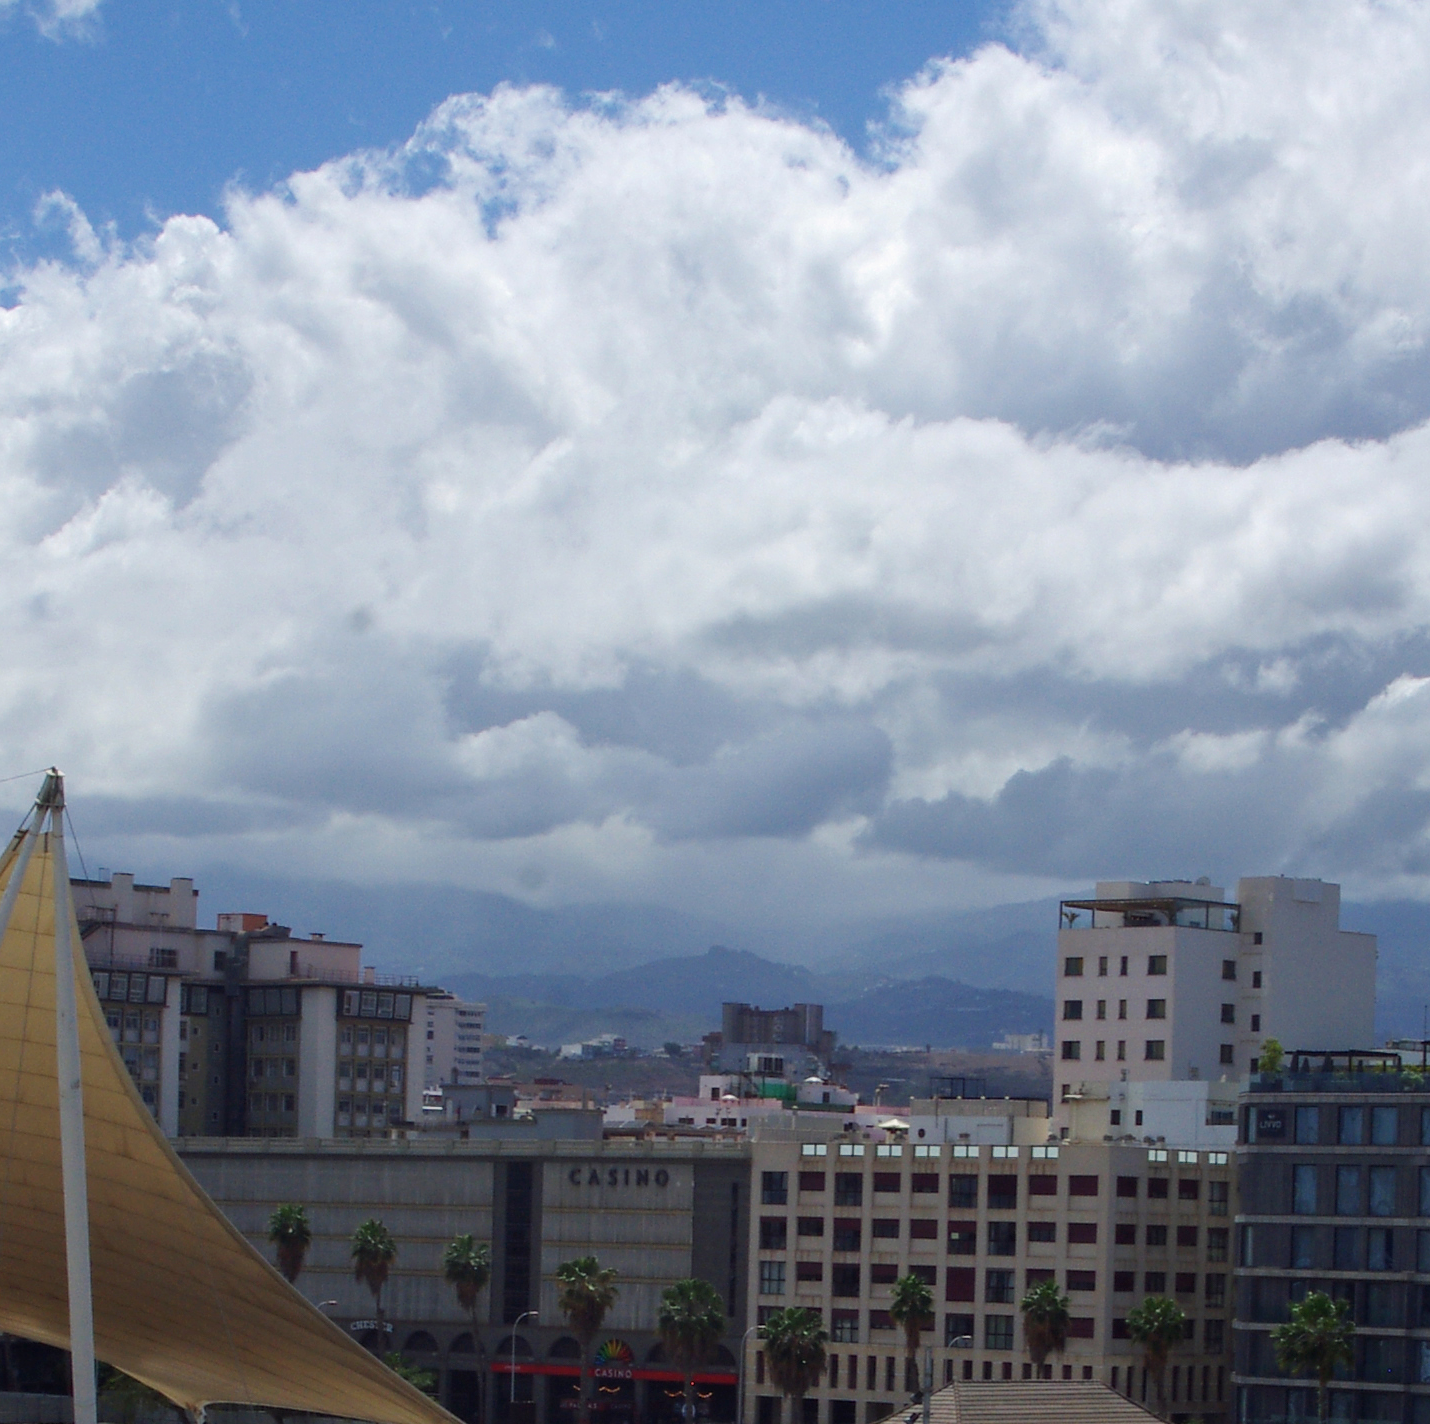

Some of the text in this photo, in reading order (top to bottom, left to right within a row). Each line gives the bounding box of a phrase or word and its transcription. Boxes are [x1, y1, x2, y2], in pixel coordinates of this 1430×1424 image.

[569, 1168, 669, 1187] CASINO
[350, 1320, 394, 1334] CHESR
[595, 1368, 633, 1379] CASINO
